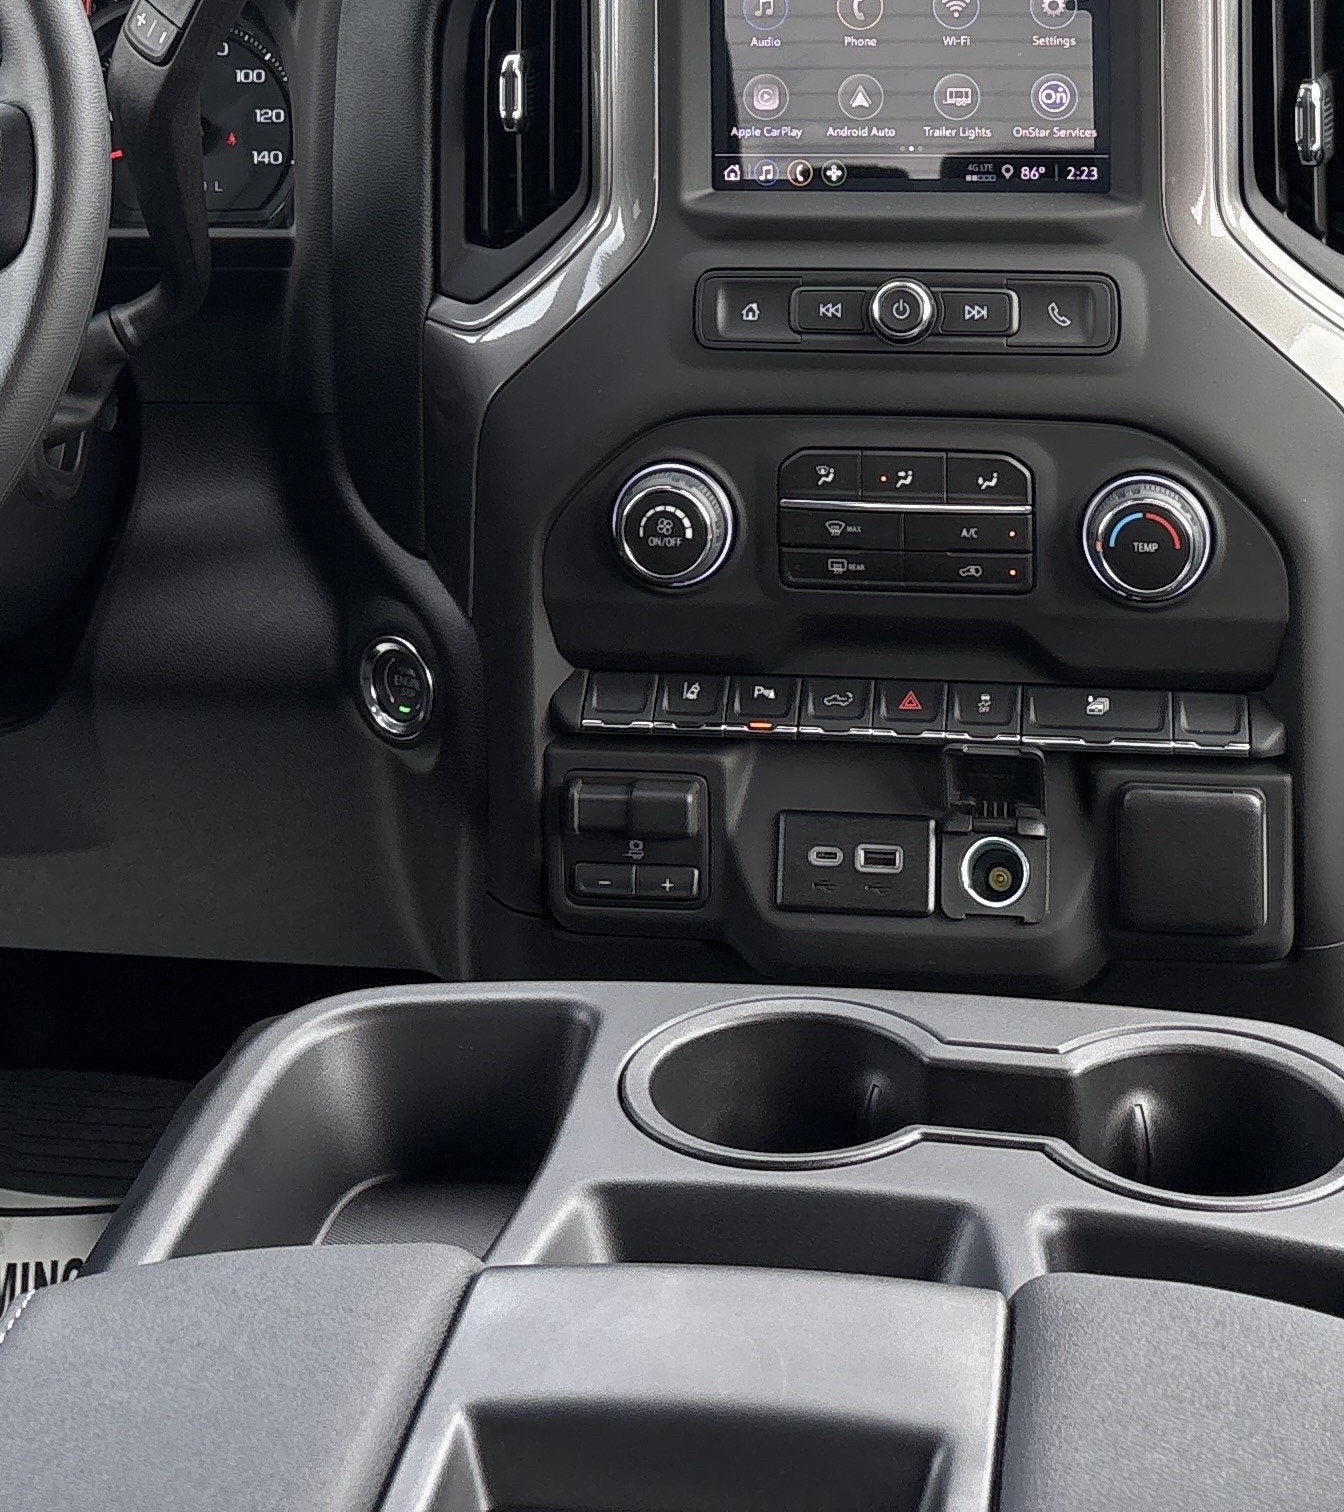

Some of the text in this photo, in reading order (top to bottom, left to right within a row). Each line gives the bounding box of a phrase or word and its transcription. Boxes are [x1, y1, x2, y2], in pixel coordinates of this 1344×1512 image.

[750, 37, 781, 47] Audio
[844, 36, 877, 47] Phone
[942, 36, 971, 46] Wi-Fi
[1032, 36, 1077, 49] Settings
[235, 69, 266, 83] 100
[255, 109, 285, 123] 120
[730, 127, 803, 139] Apple CarPlay
[826, 126, 896, 137] Android Auto
[923, 126, 992, 139] Trailer Lights
[1013, 126, 1097, 137] OnStar Services
[252, 150, 283, 165] 140
[967, 163, 994, 172] 4G LTE
[1066, 166, 1098, 180] 2:23
[846, 525, 862, 534] MAX
[960, 527, 979, 539] A/C
[648, 537, 683, 548] ON/OFF
[1133, 541, 1159, 553] TEMP
